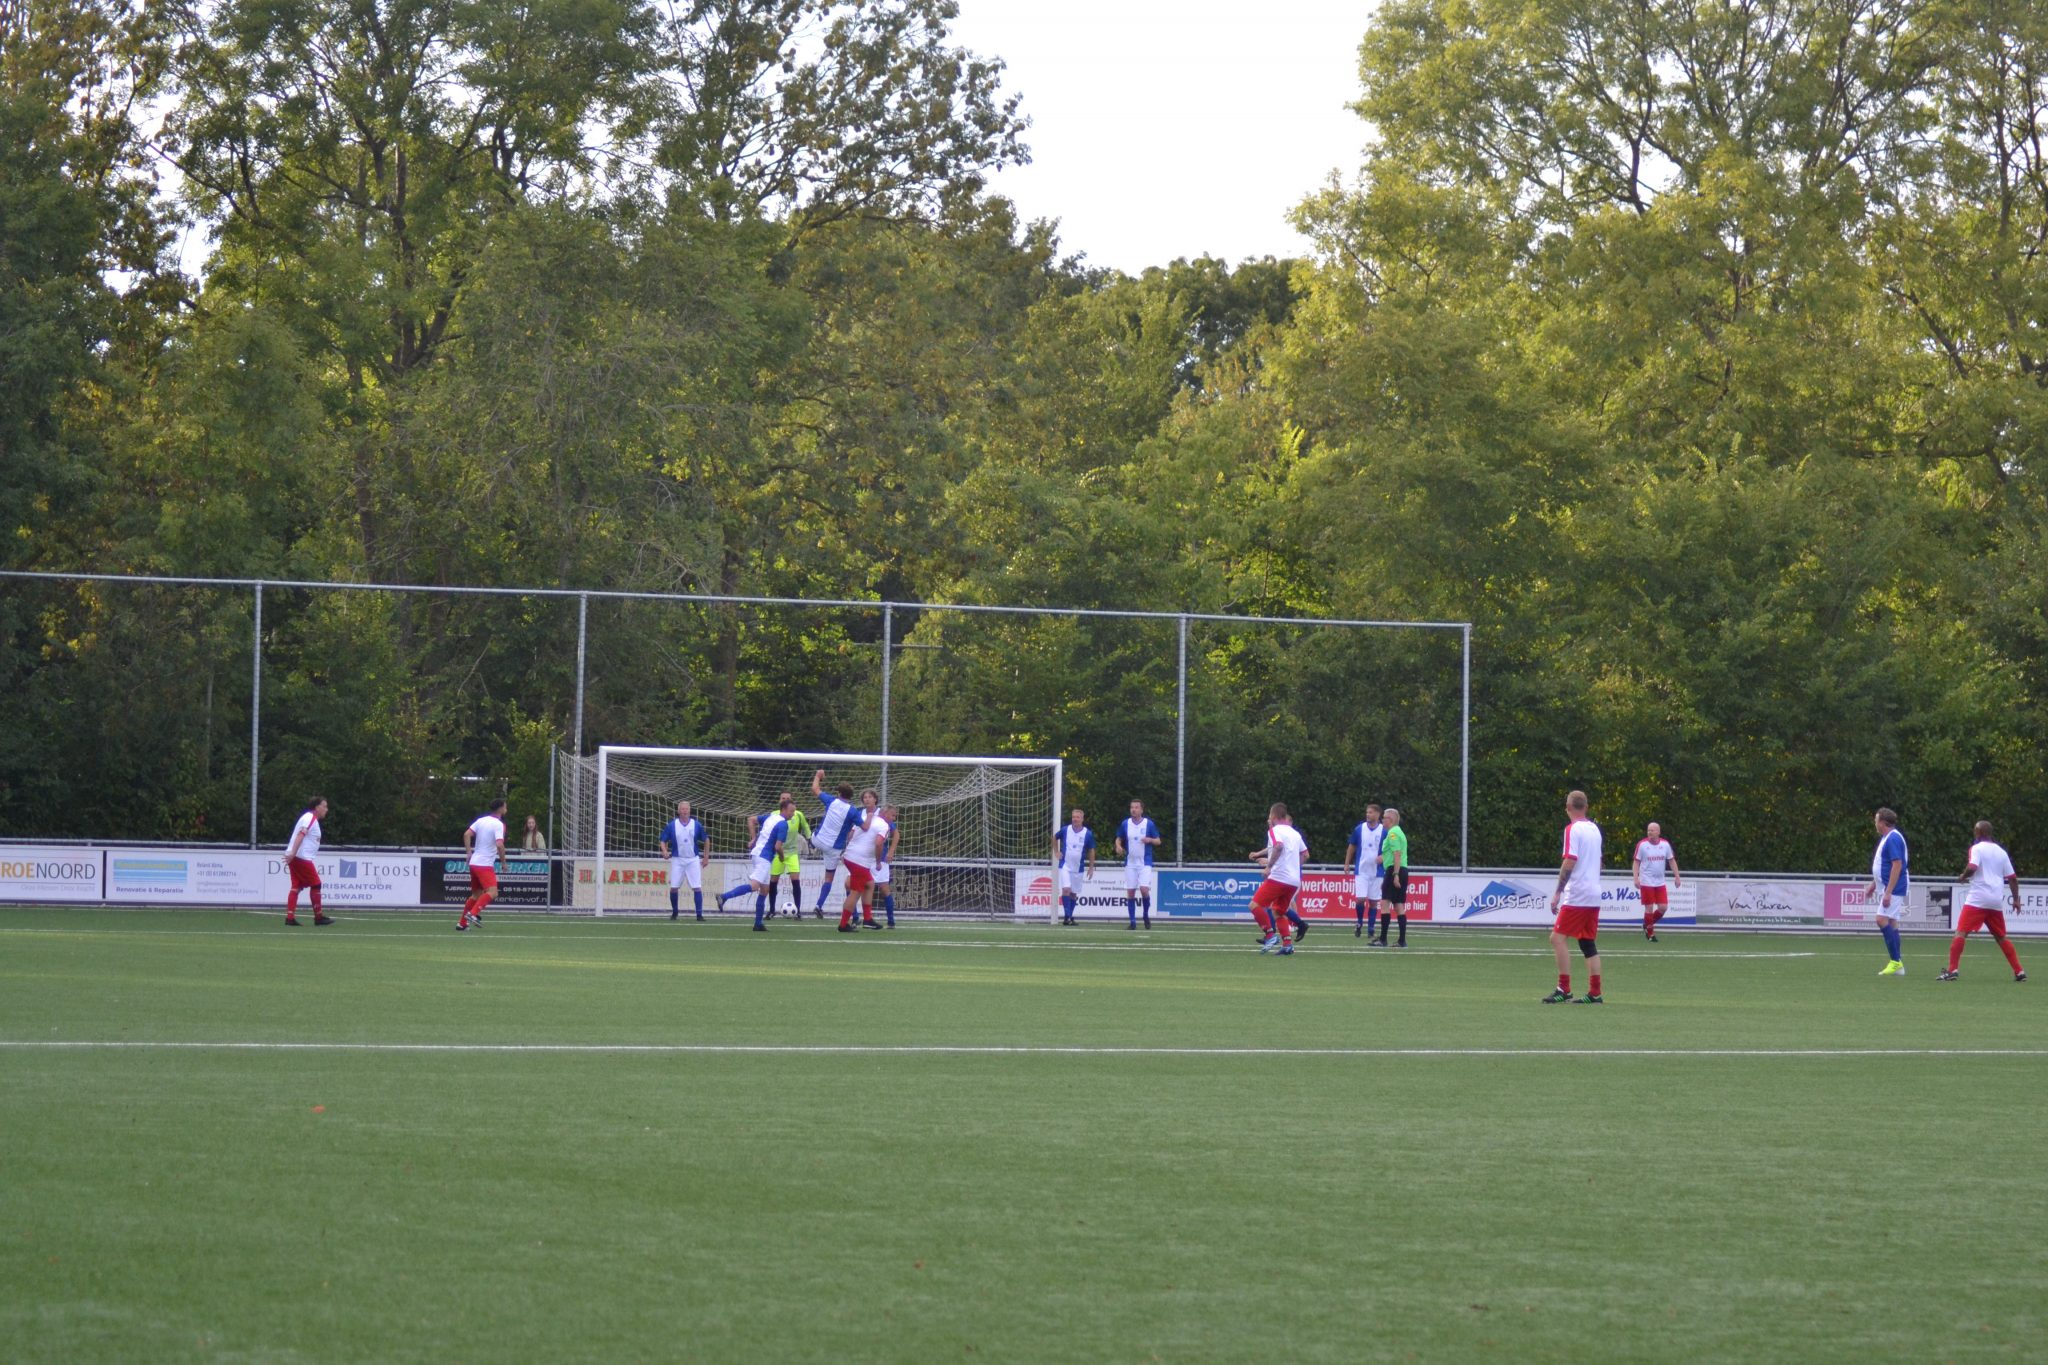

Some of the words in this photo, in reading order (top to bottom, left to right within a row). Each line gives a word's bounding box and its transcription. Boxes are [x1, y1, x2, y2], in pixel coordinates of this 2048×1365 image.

[362, 862, 419, 878] Troost
[578, 869, 671, 885] HARSM
[1172, 880, 1225, 891] YKEMA
[1225, 878, 1265, 894] OPTI
[1449, 895, 1465, 907] de
[1471, 894, 1546, 909] KLOKSLAG
[1600, 891, 1614, 901] er
[1616, 887, 1641, 901] Wer
[1844, 890, 1864, 905] DE
[1413, 900, 1428, 911] hier
[1728, 897, 1752, 911] Van
[1756, 899, 1793, 911] Buren
[2019, 909, 2048, 917] ONTEXT
